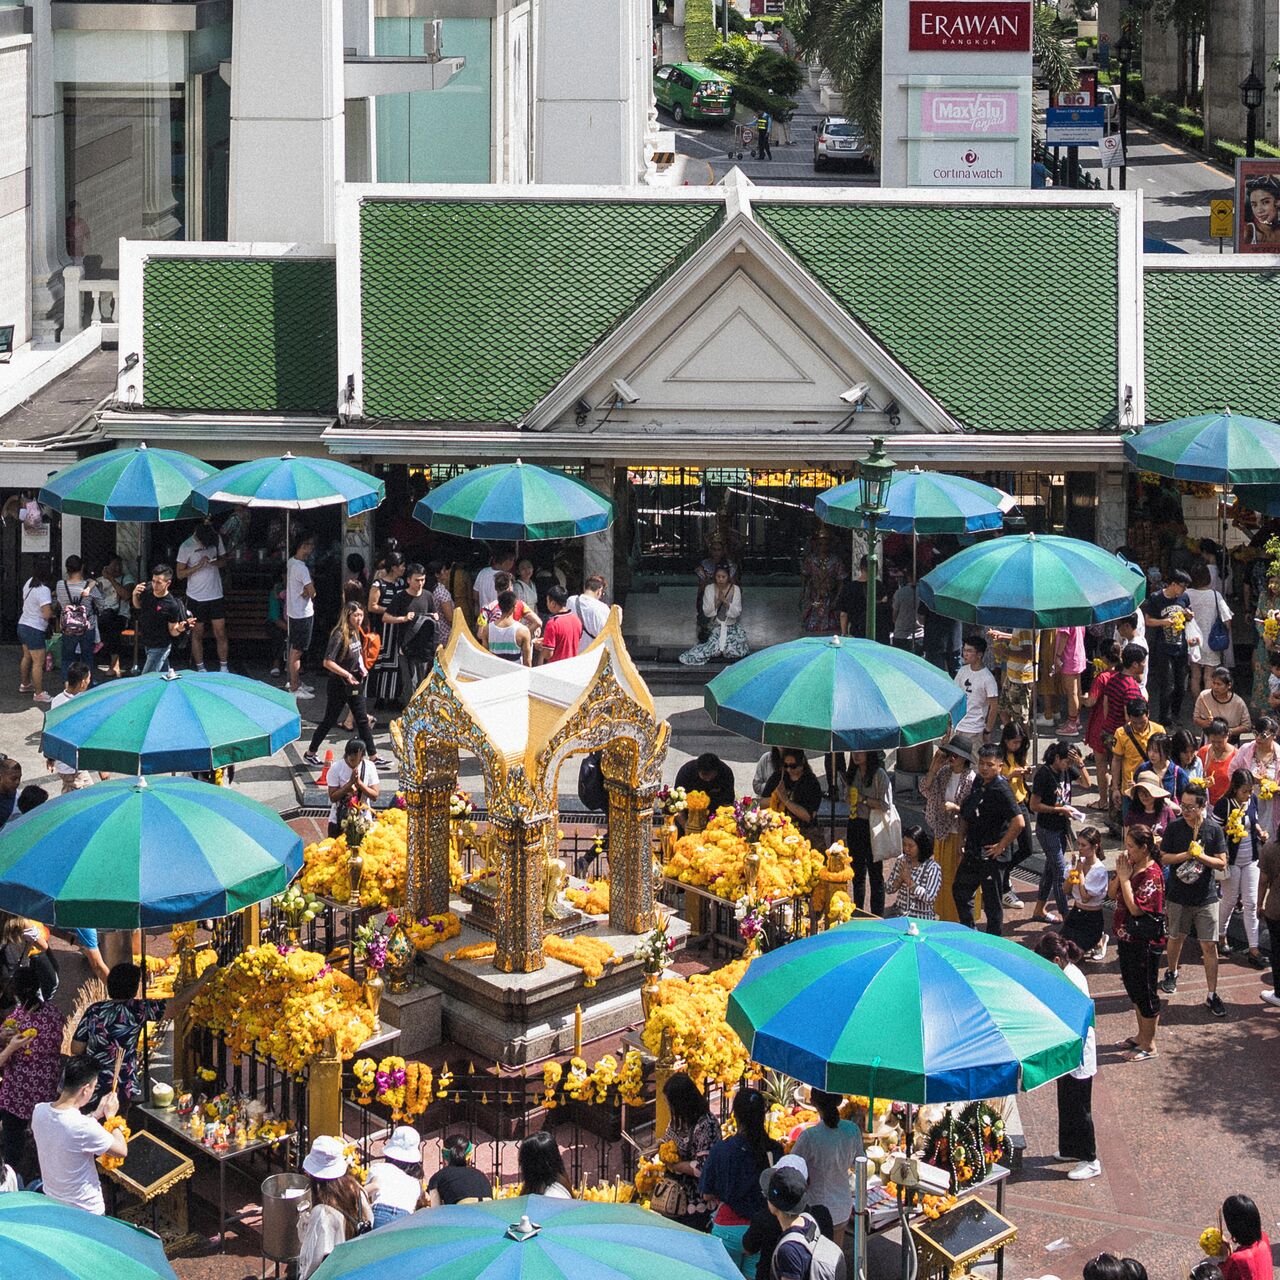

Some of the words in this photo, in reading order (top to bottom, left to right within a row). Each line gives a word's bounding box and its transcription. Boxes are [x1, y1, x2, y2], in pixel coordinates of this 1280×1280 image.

[921, 13, 1018, 38] ERAWAN
[939, 94, 1001, 119] MaxValu
[972, 168, 1003, 179] watch
